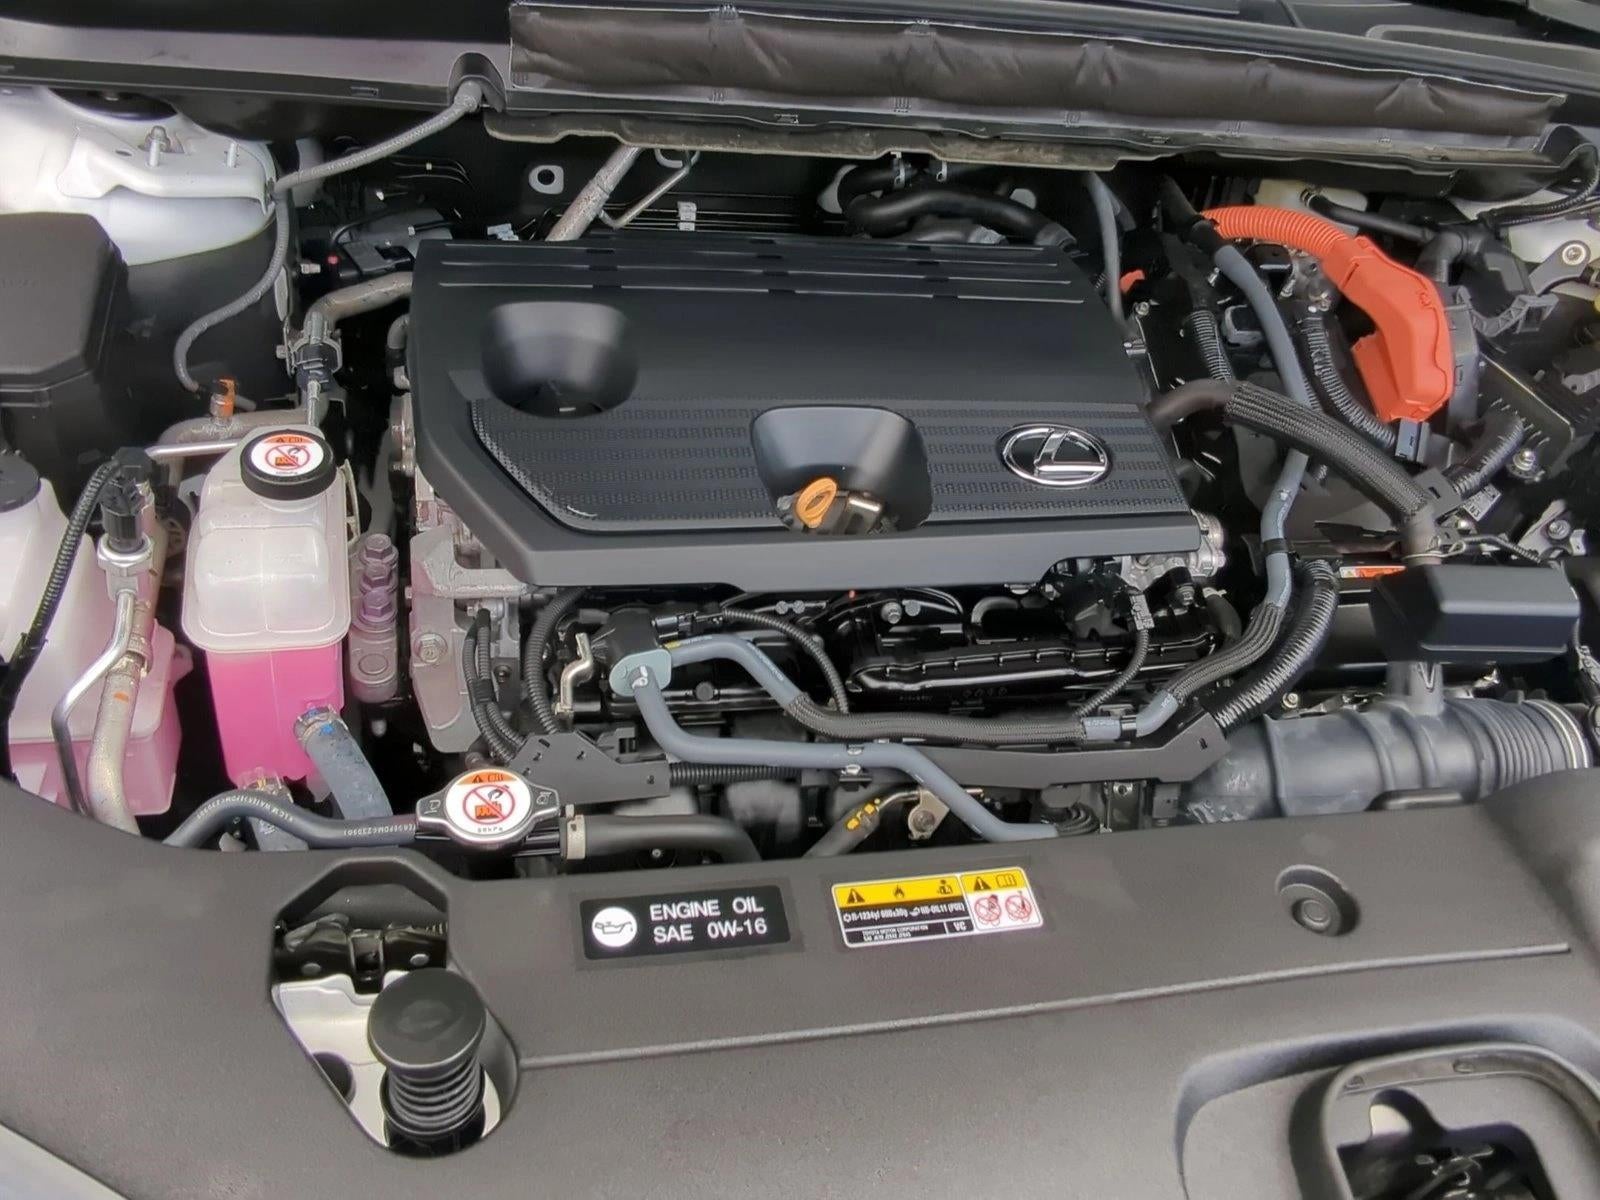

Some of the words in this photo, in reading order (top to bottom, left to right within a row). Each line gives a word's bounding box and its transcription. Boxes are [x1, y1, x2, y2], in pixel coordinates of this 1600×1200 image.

[650, 899, 721, 921] ENGINE
[732, 896, 765, 914] OIL
[653, 924, 694, 944] SAE
[707, 918, 768, 939] 0W-16
